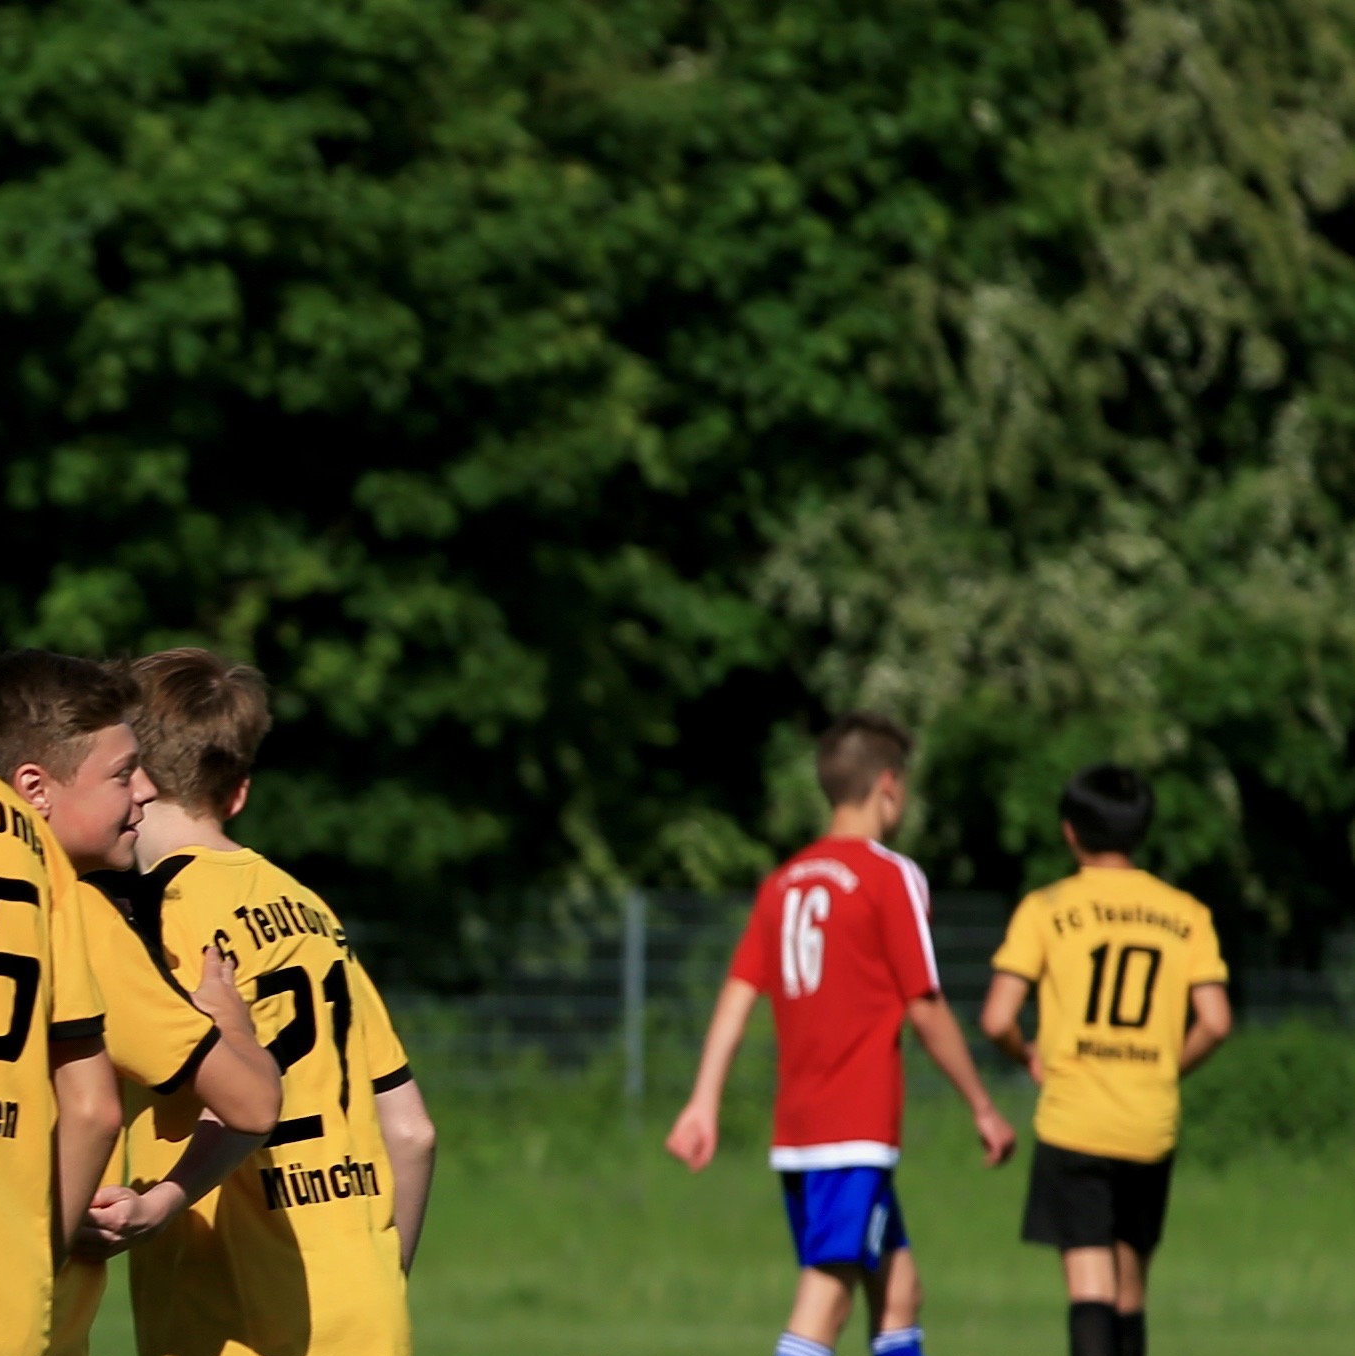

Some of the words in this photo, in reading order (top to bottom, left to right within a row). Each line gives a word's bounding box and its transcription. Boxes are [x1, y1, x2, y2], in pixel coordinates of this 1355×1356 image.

[202, 929, 239, 970] C
[781, 884, 830, 1000] 16
[1052, 909, 1083, 938] FC
[1085, 940, 1163, 1029] 10
[255, 958, 352, 1149] 21
